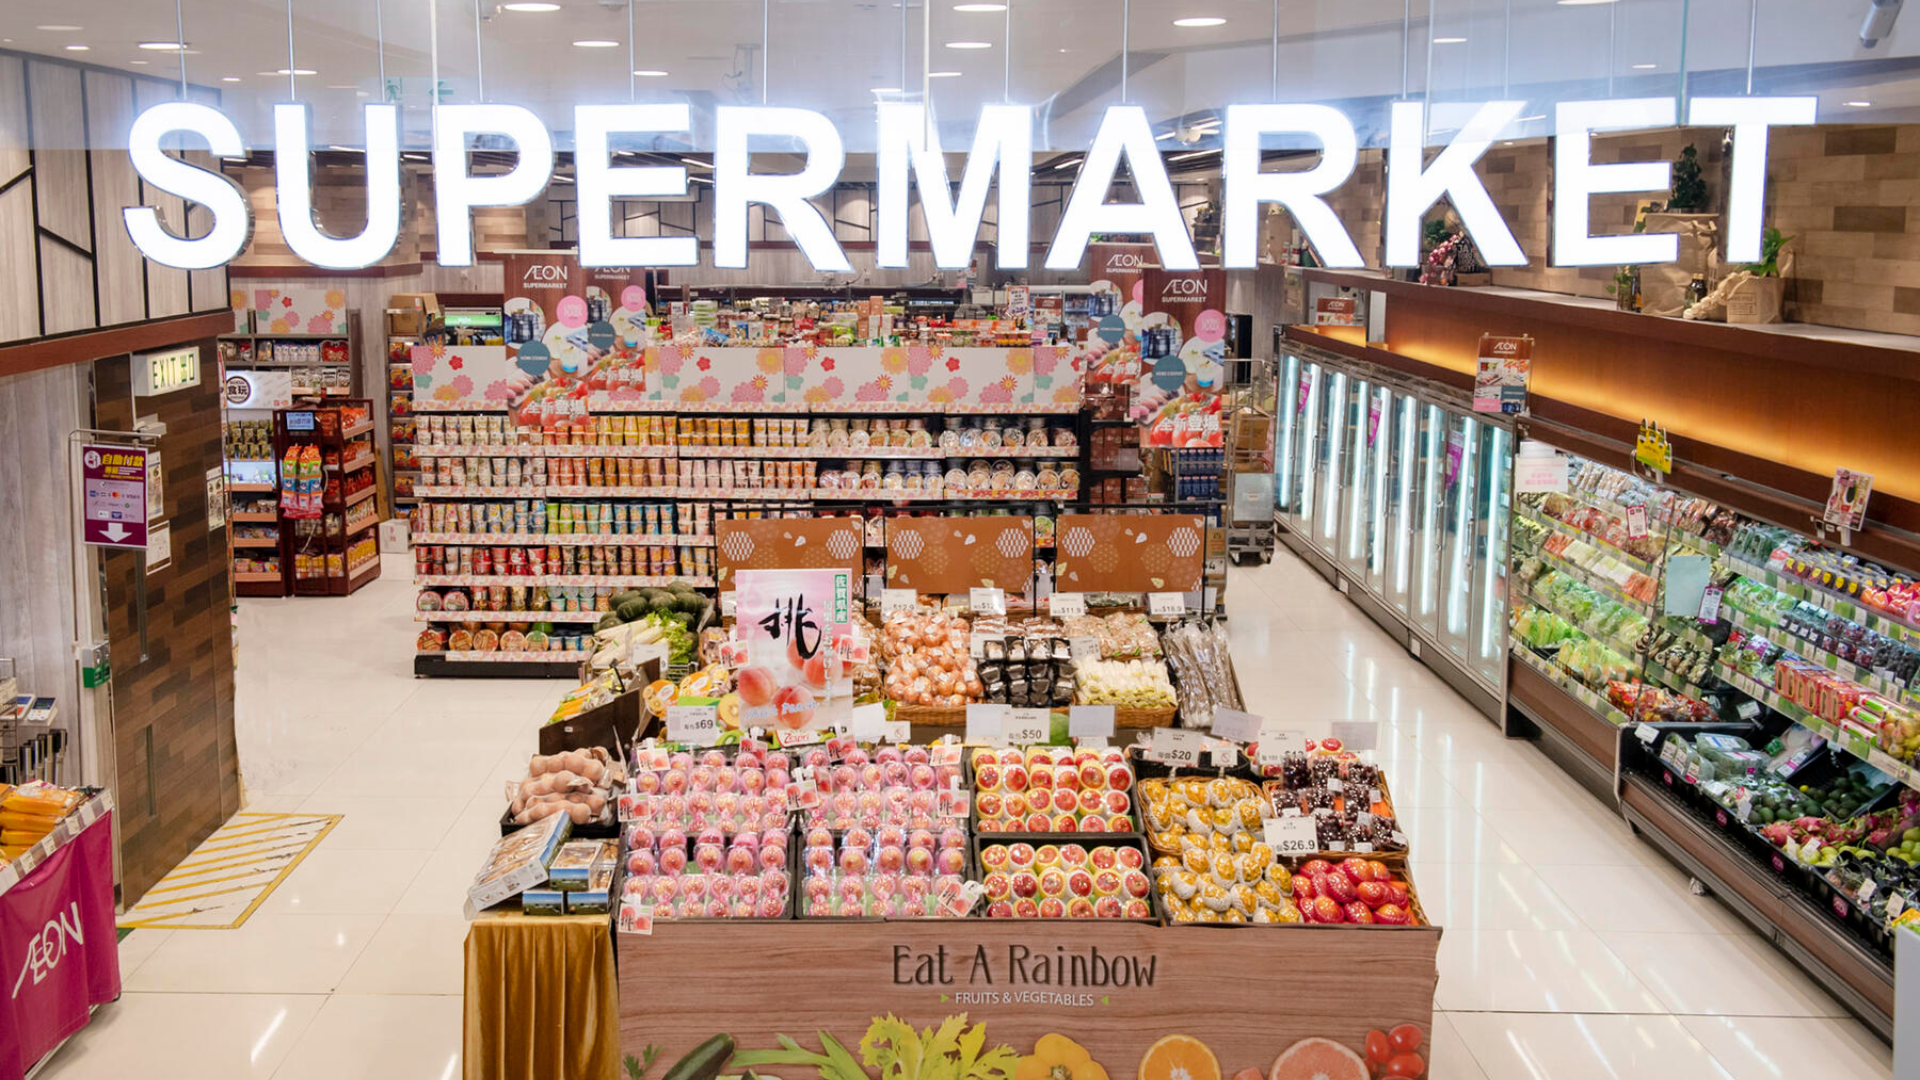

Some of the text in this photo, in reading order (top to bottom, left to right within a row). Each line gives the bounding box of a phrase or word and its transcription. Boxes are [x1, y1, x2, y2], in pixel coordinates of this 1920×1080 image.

[123, 98, 1819, 272] SUPERMARKET
[152, 356, 176, 389] EXIT
[1159, 413, 1219, 431] 全新登場
[1022, 729, 1042, 739] $50
[1171, 749, 1191, 761] $20
[1282, 839, 1316, 851] $26.9
[892, 943, 1157, 988] Eat A Rainbow
[955, 991, 1095, 1007] FRUITS & VEGETABLES
